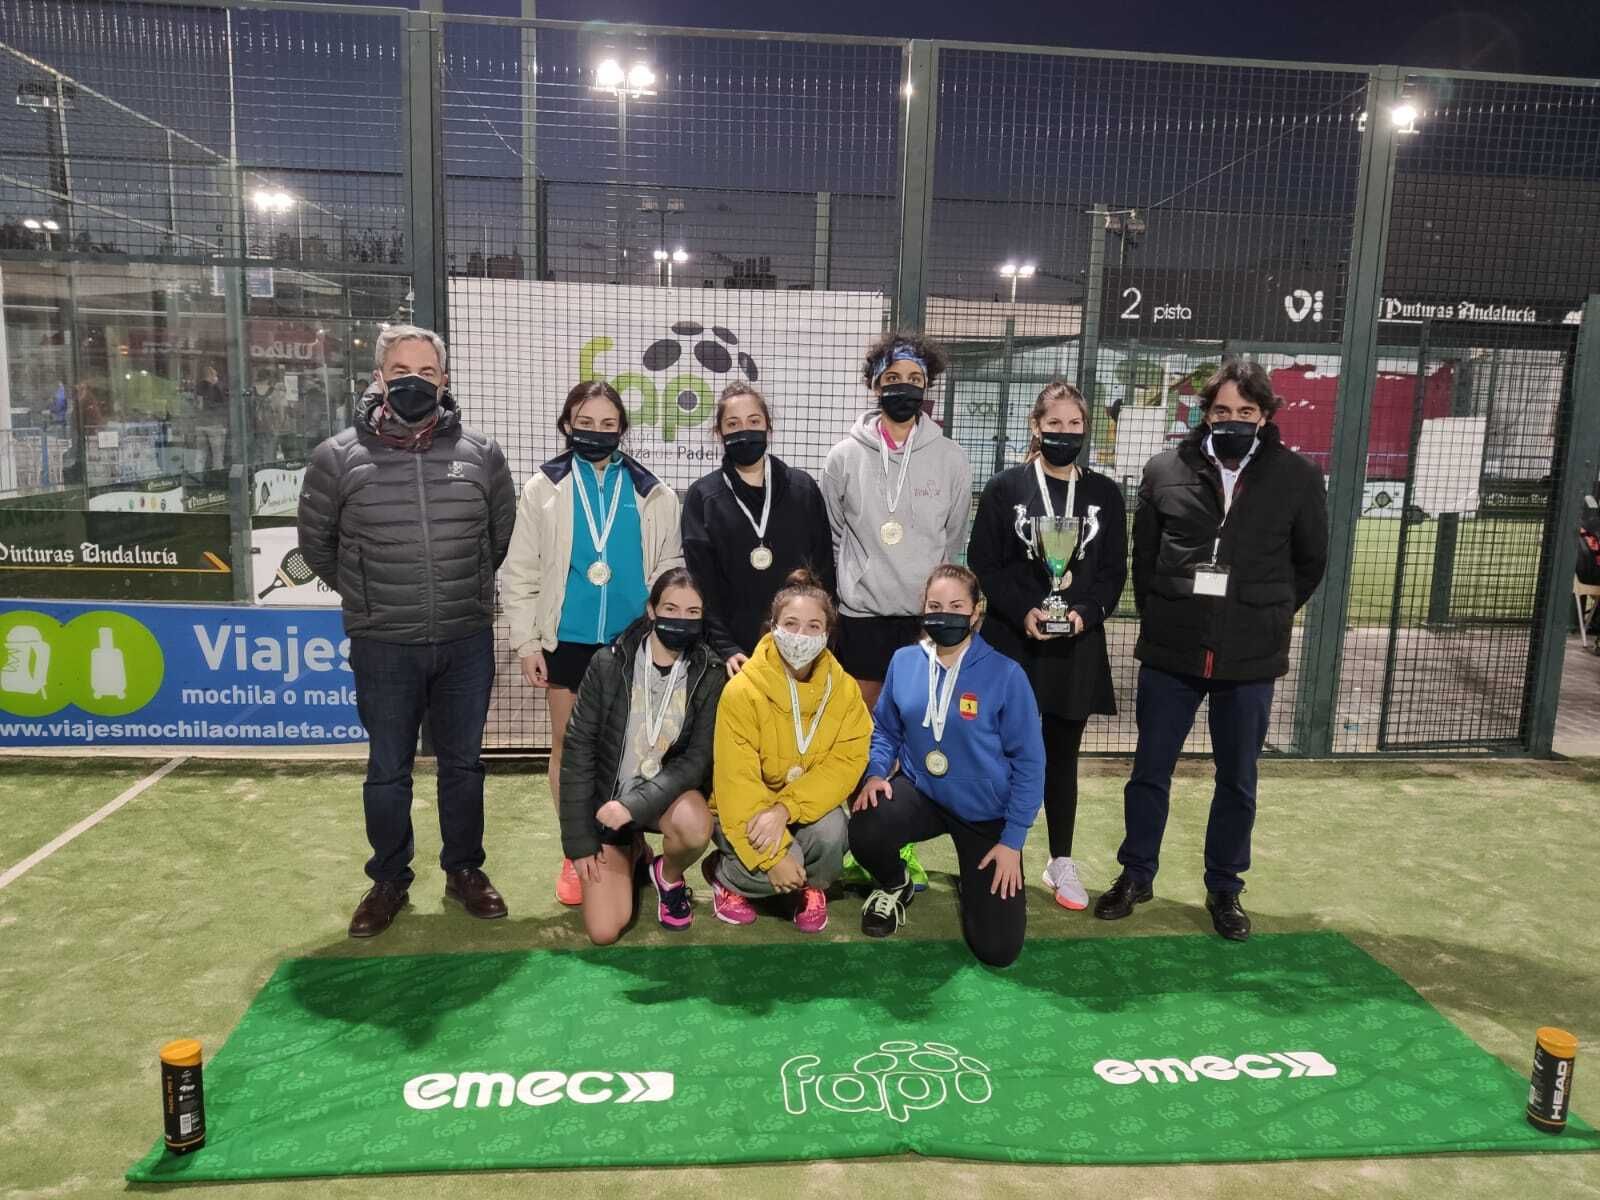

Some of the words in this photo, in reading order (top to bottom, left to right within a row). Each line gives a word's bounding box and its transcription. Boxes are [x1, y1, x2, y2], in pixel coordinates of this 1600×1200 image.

[1120, 287, 1141, 319] 2
[1153, 303, 1192, 323] pista
[677, 446, 719, 461] Padel
[182, 686, 276, 706] mochila
[283, 690, 297, 705] o
[1093, 1053, 1283, 1085] emec
[403, 1071, 615, 1109] emec
[1550, 1060, 1568, 1120] HEAD
